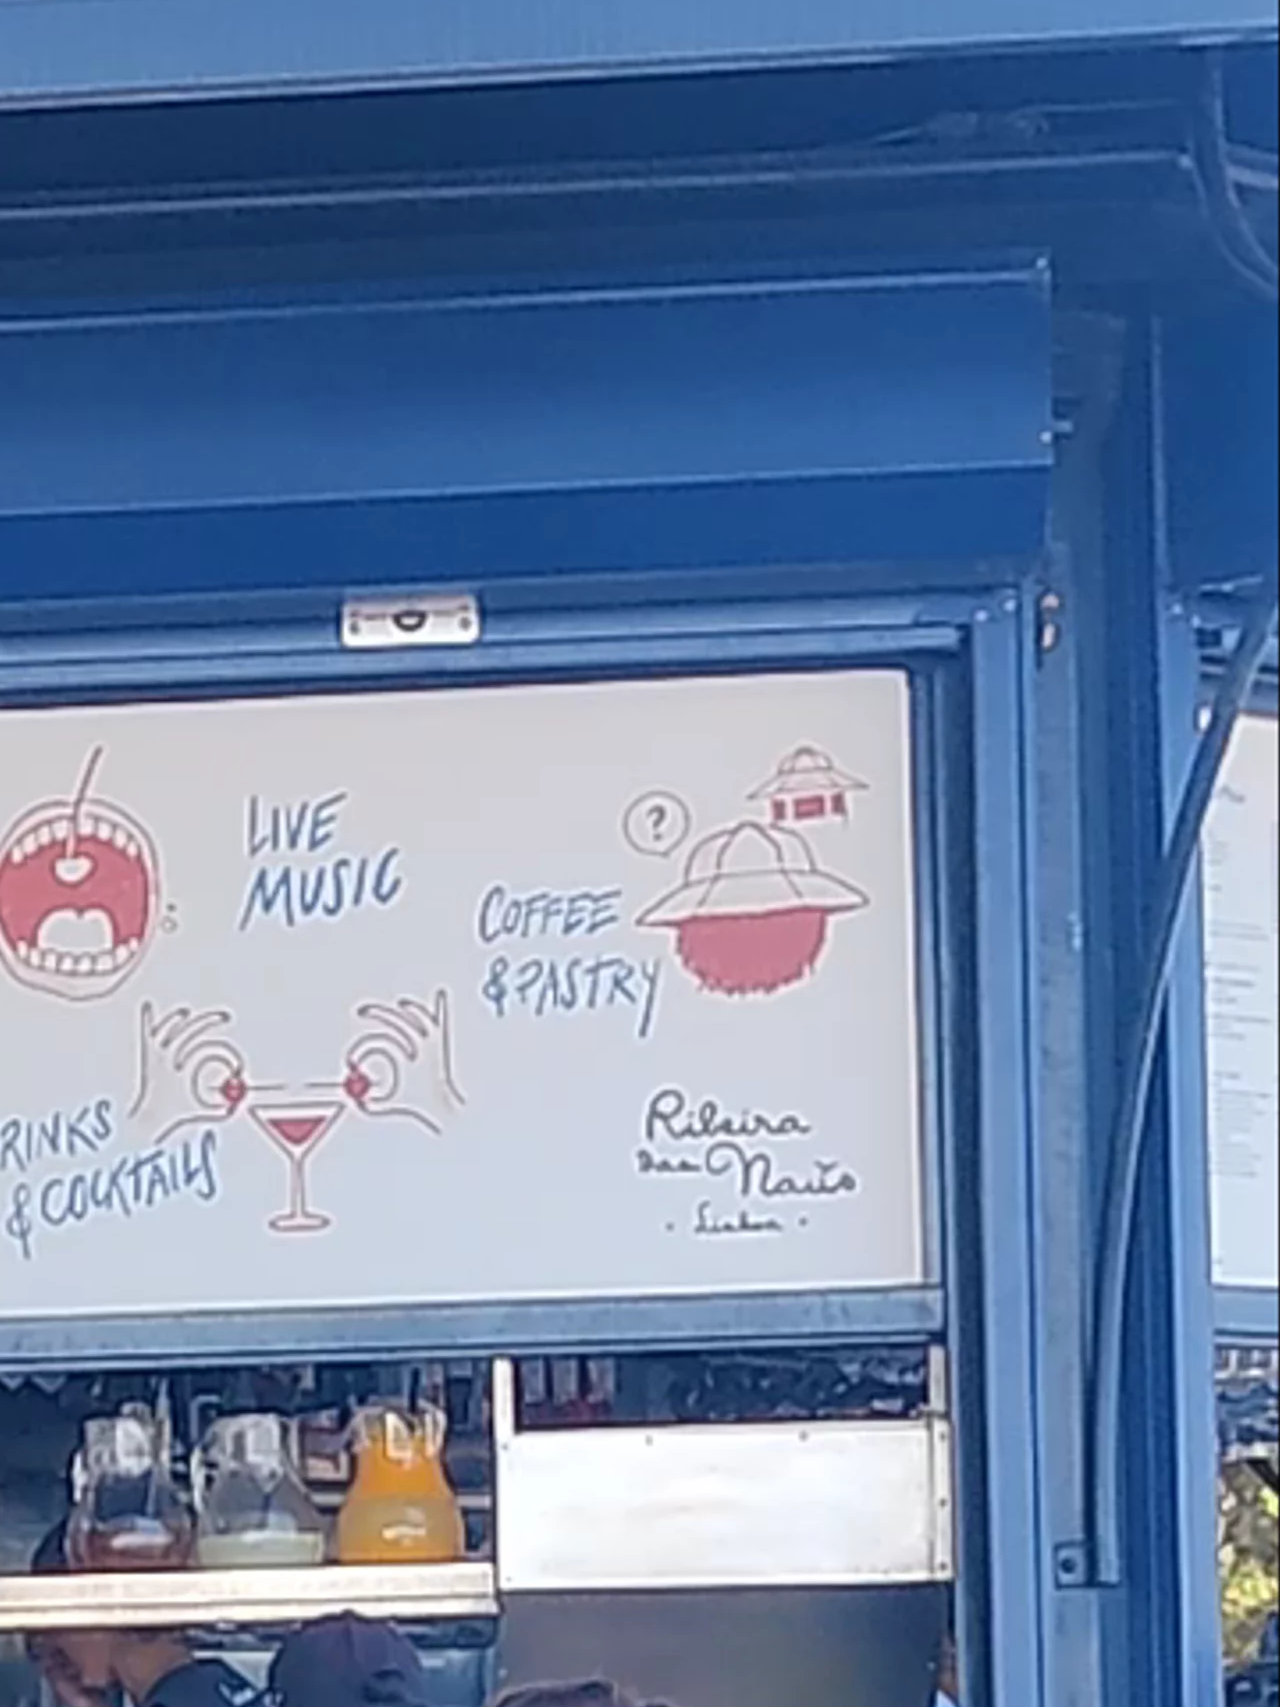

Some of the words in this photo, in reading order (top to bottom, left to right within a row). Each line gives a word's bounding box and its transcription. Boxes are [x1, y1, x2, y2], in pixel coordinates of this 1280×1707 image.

[246, 792, 348, 858] LIVE
[239, 847, 402, 931] MUSIC
[479, 885, 622, 943] COFFEE
[645, 1089, 812, 1141] Ribeira
